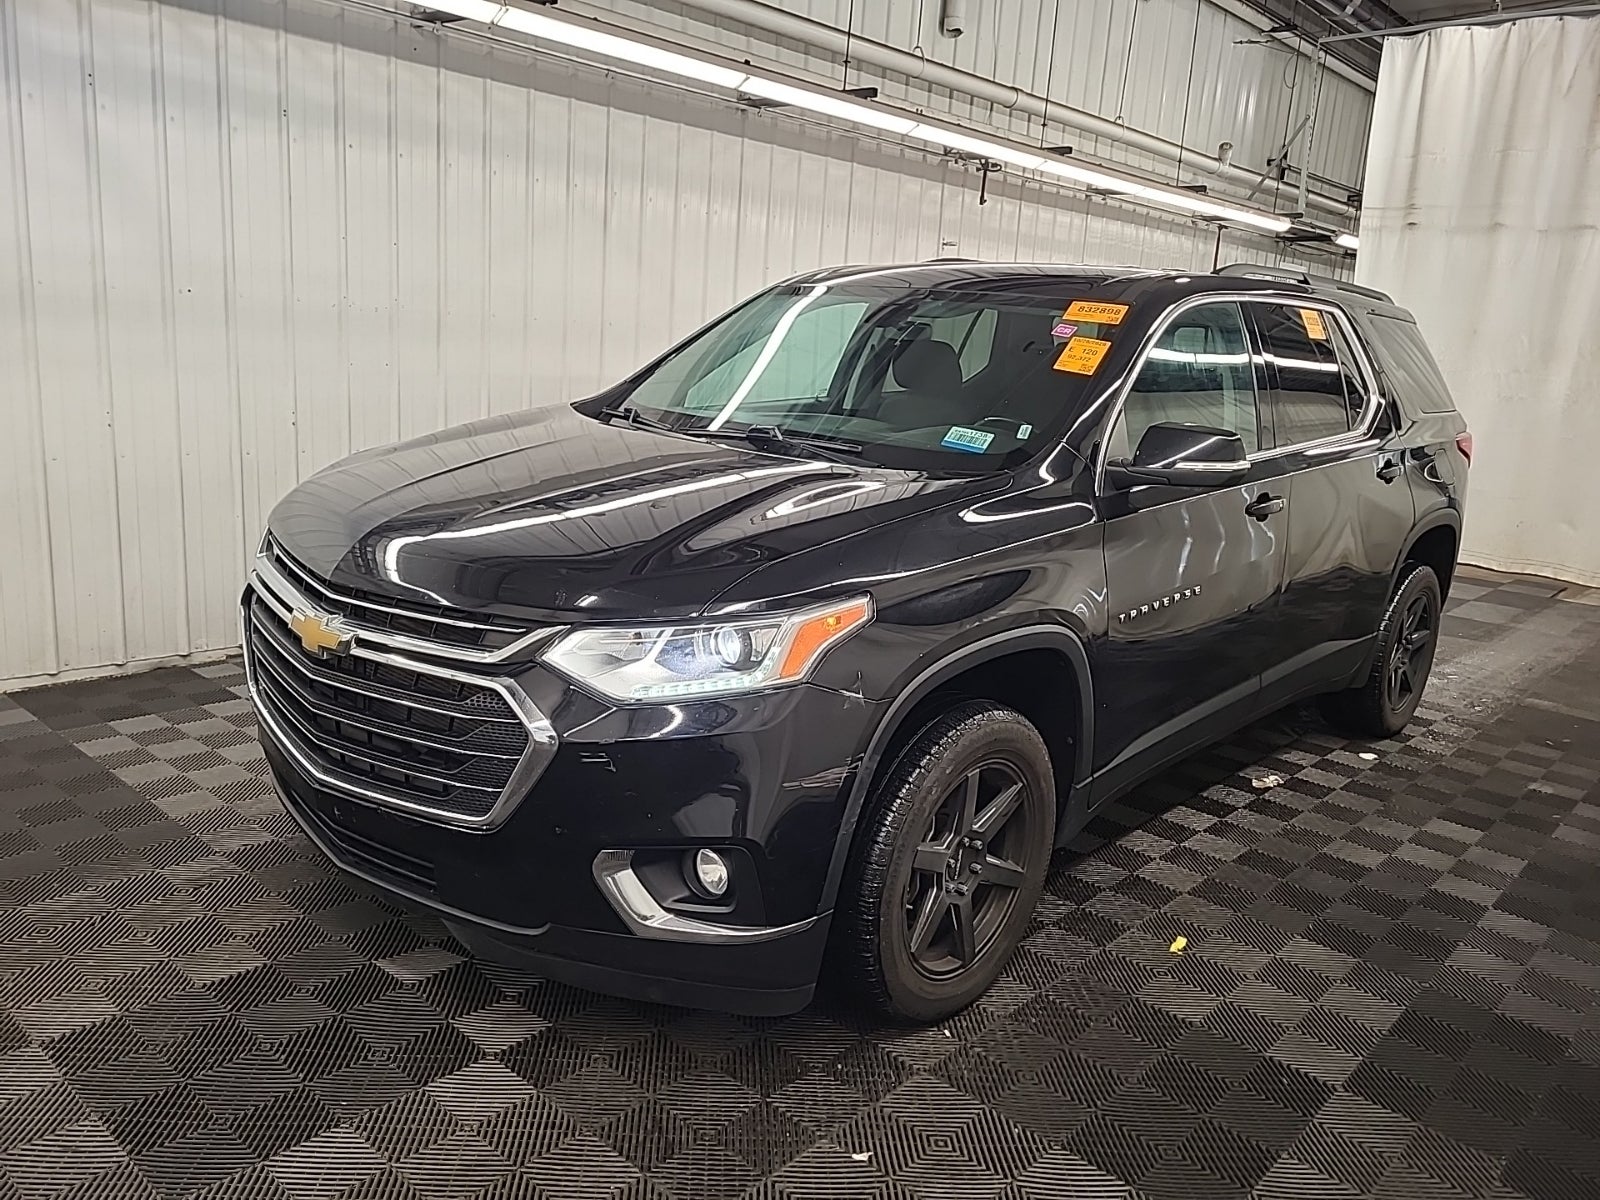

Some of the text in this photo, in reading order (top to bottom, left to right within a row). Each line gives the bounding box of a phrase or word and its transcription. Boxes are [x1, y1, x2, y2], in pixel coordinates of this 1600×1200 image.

[1077, 305, 1121, 316] 832898
[1056, 326, 1072, 335] CR
[1081, 347, 1098, 357] 120
[1118, 585, 1202, 624] TRAVERSE
